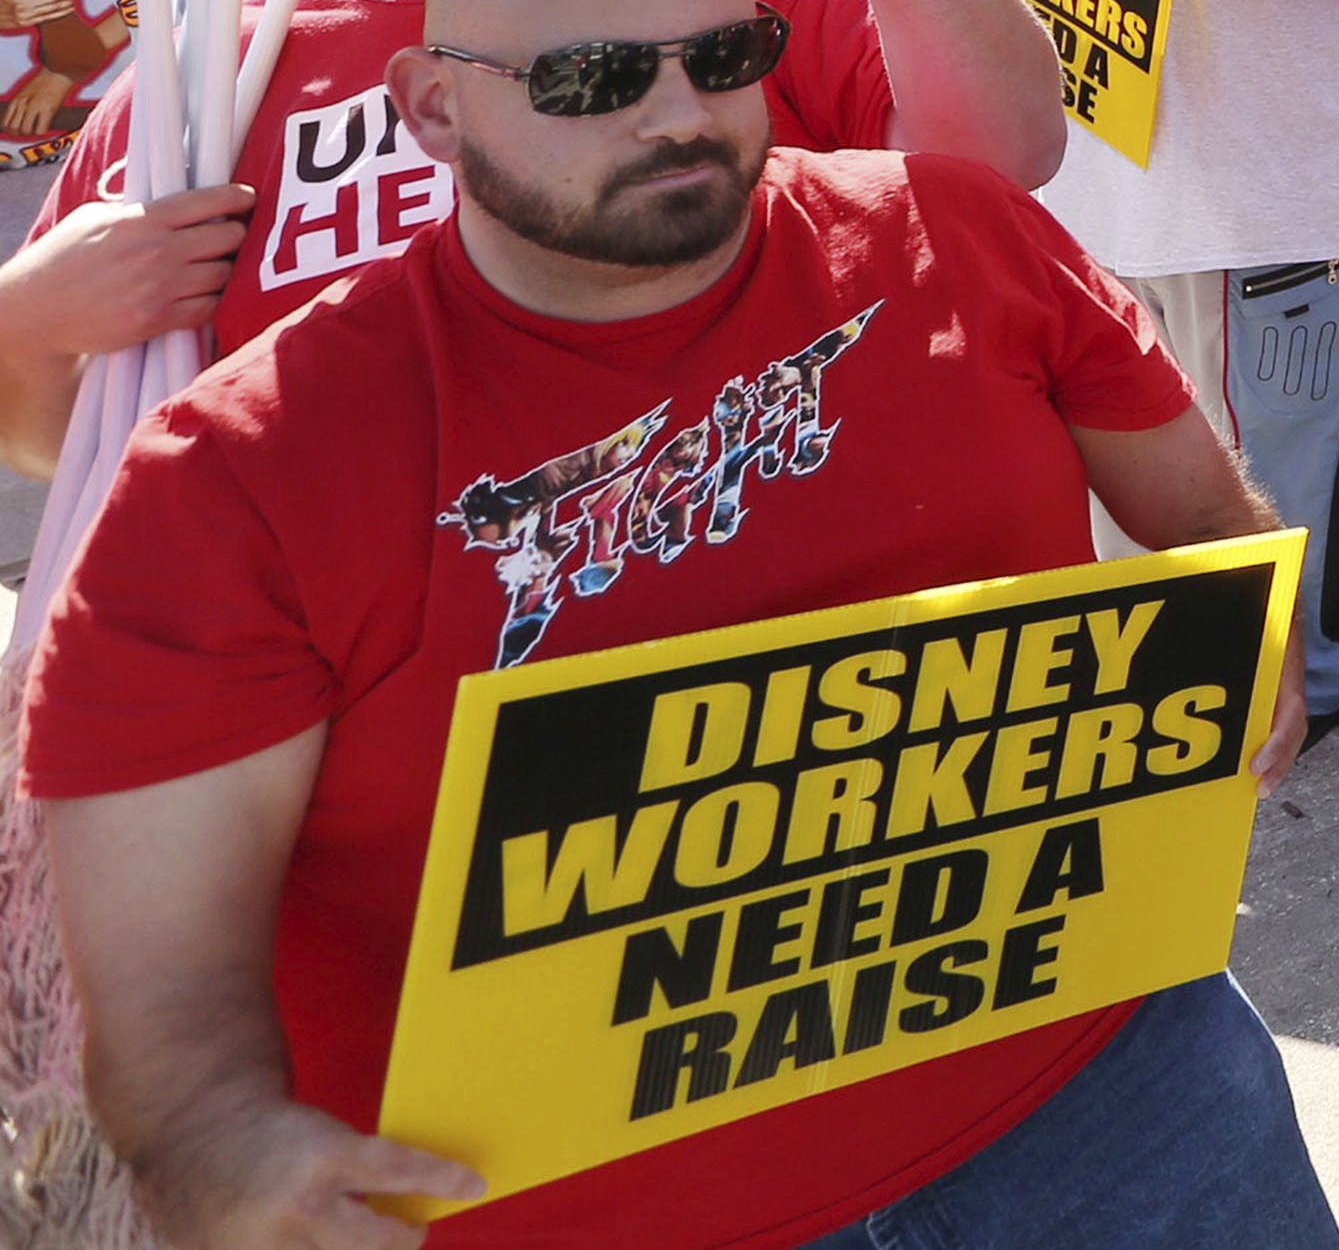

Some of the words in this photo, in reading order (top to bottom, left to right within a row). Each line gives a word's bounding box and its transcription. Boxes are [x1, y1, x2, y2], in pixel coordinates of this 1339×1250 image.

[1083, 40, 1110, 90] A
[637, 599, 1166, 794] DISNEY
[502, 685, 1229, 938] WORKERS
[611, 848, 989, 1027] NEED
[1016, 817, 1105, 915] A
[628, 914, 1068, 1123] RAISE
